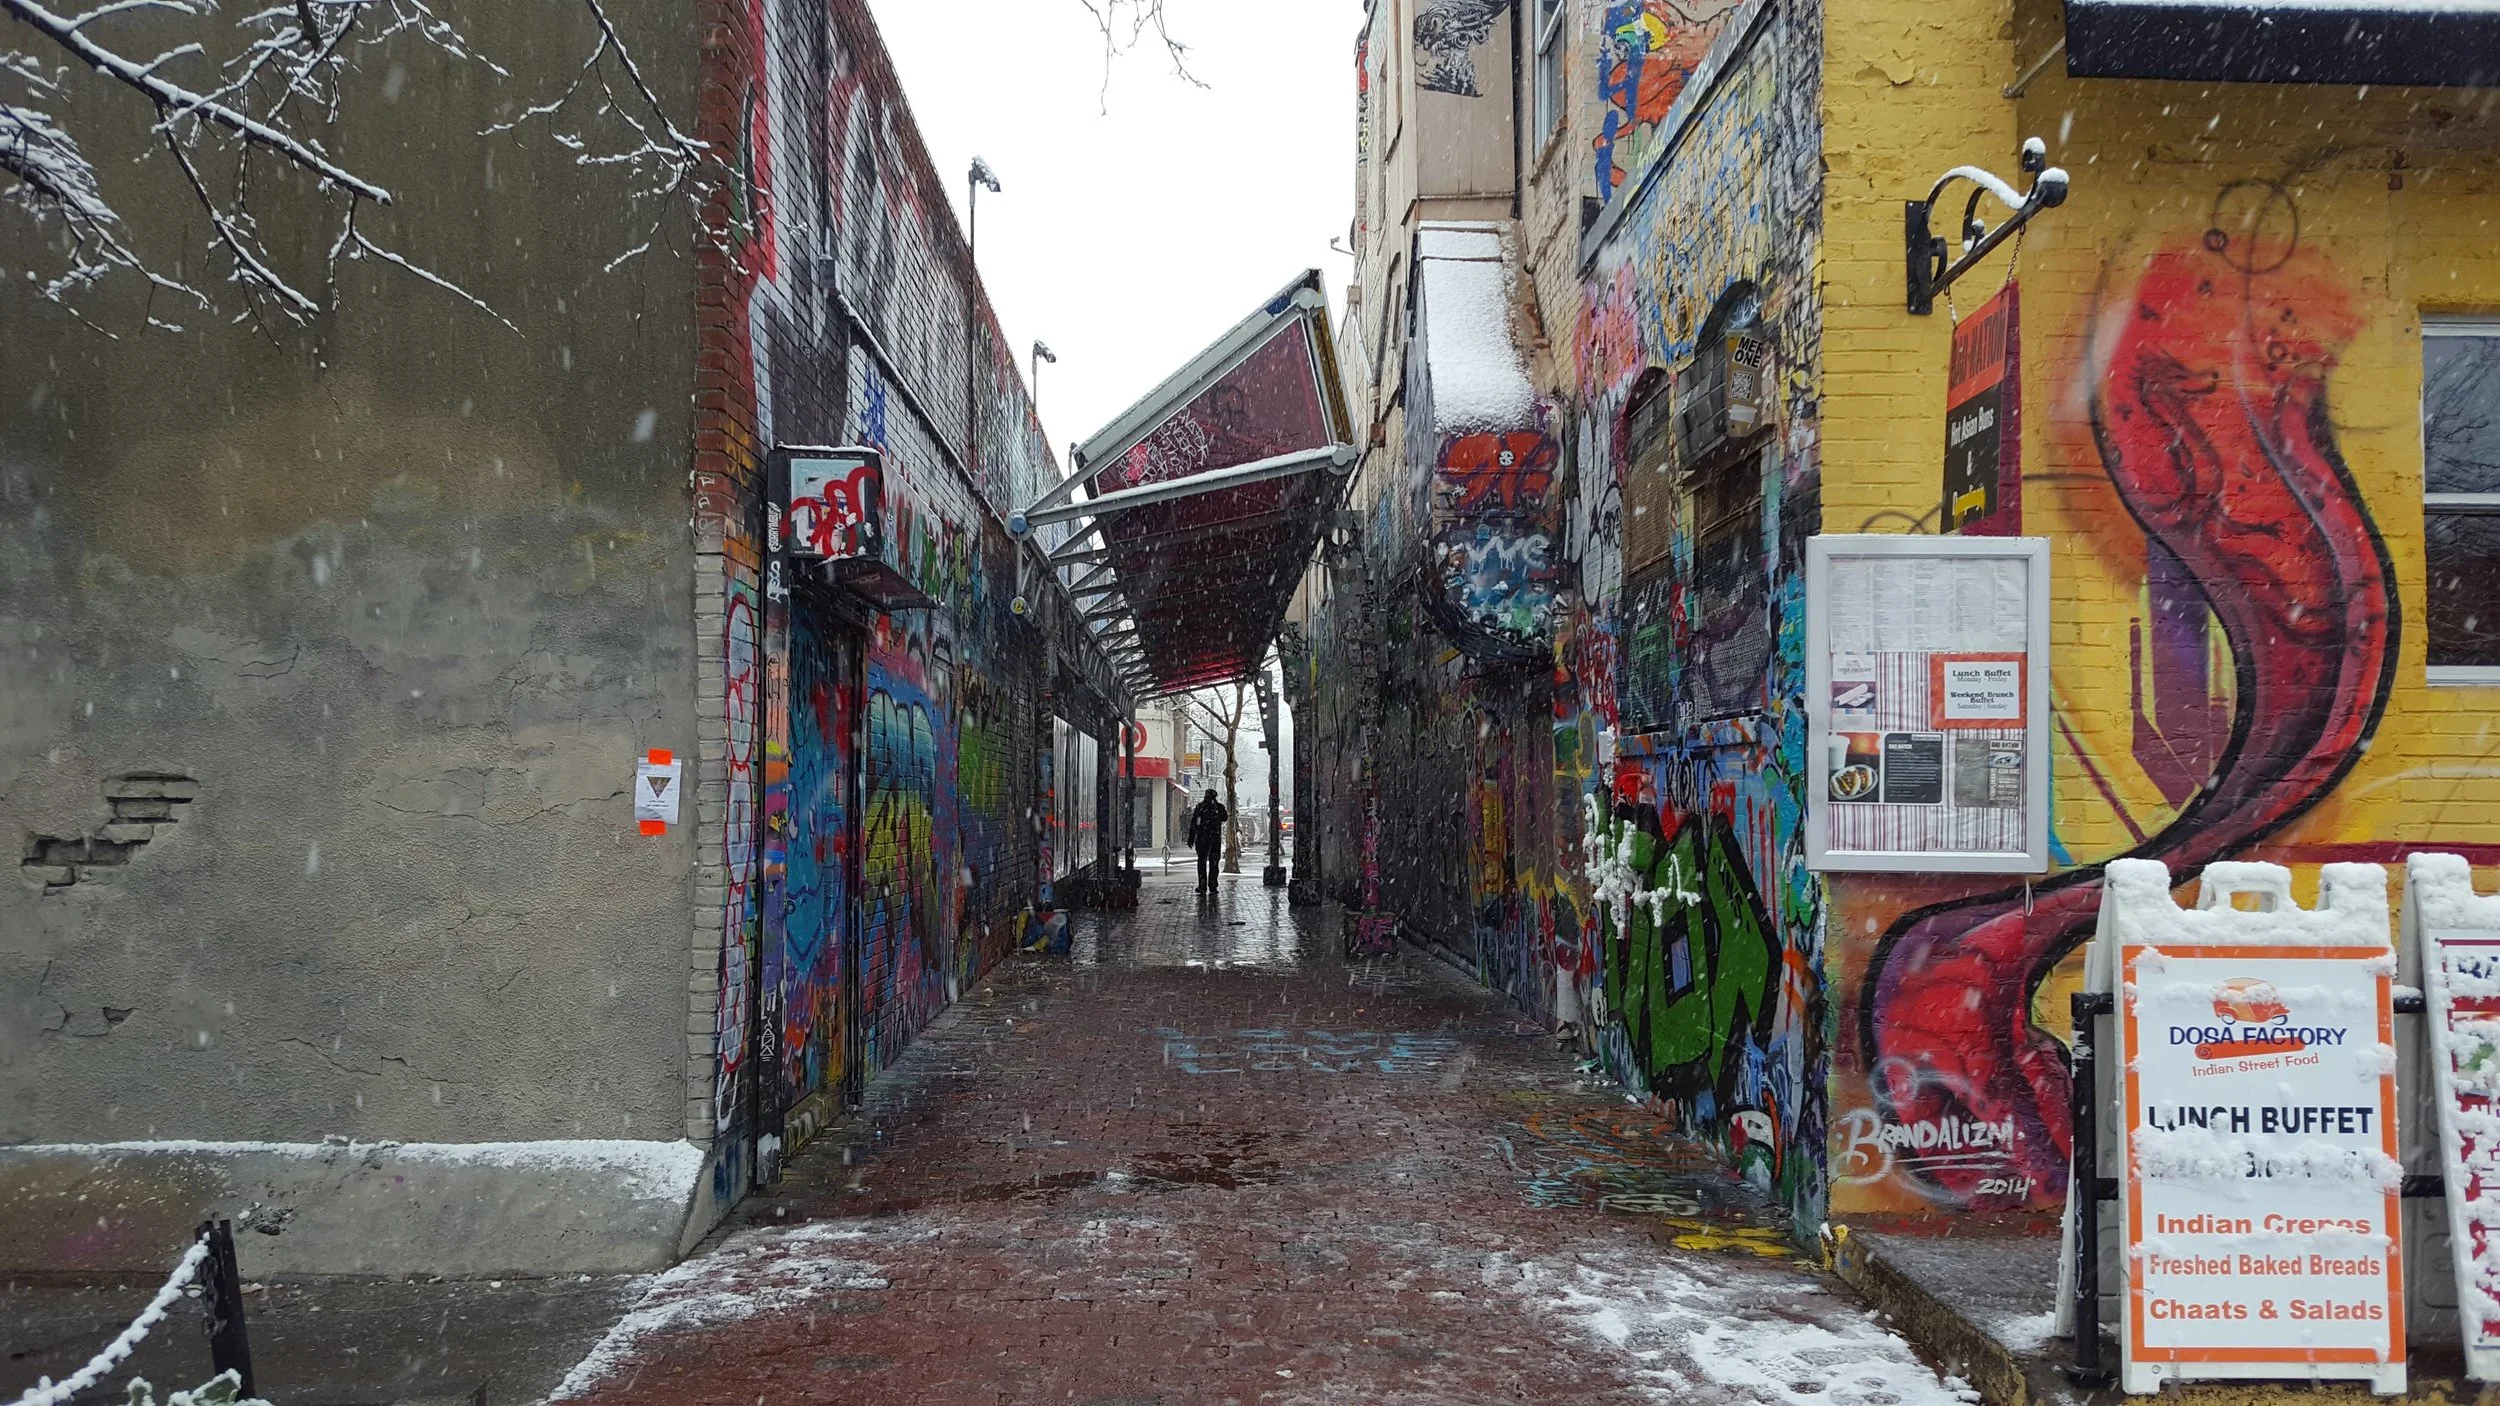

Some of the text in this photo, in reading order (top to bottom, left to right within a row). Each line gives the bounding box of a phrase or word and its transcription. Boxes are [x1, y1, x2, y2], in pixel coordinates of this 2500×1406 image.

[1734, 350, 1761, 369] ONE
[1951, 406, 1995, 448] Hot Asian Buns
[1957, 676, 1981, 684] Monday
[1984, 669, 2012, 677] Buffet
[1957, 703, 1981, 711] Saturday
[2169, 1026, 2347, 1046] DOSA FACTORY
[2192, 1053, 2320, 1077] Indian Street Food
[2261, 1106, 2374, 1134] BUFFET
[1975, 1176, 2030, 1201] 2014
[2157, 1213, 2251, 1234] Indian
[2149, 1254, 2381, 1276] Freshed Baked Breads
[2149, 1298, 2384, 1320] Chaats & Salads
